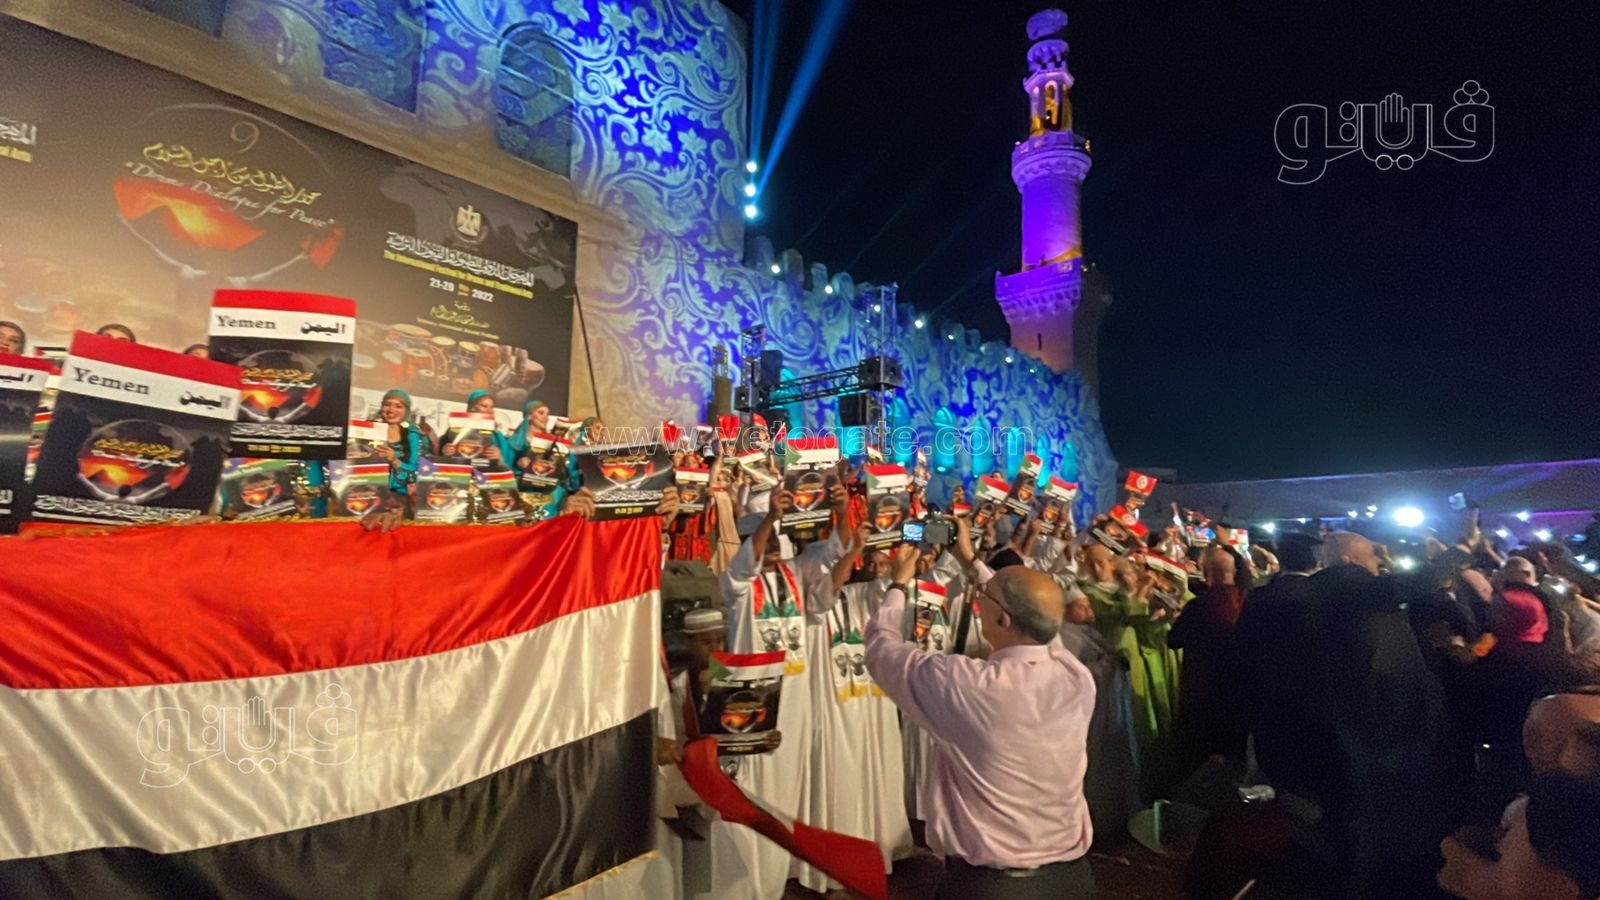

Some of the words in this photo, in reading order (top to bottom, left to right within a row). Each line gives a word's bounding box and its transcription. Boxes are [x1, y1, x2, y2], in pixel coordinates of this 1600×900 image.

[216, 315, 276, 330] Yemen
[301, 321, 347, 337] اليمن
[73, 366, 150, 396] Yemen
[178, 391, 232, 411] اليمن
